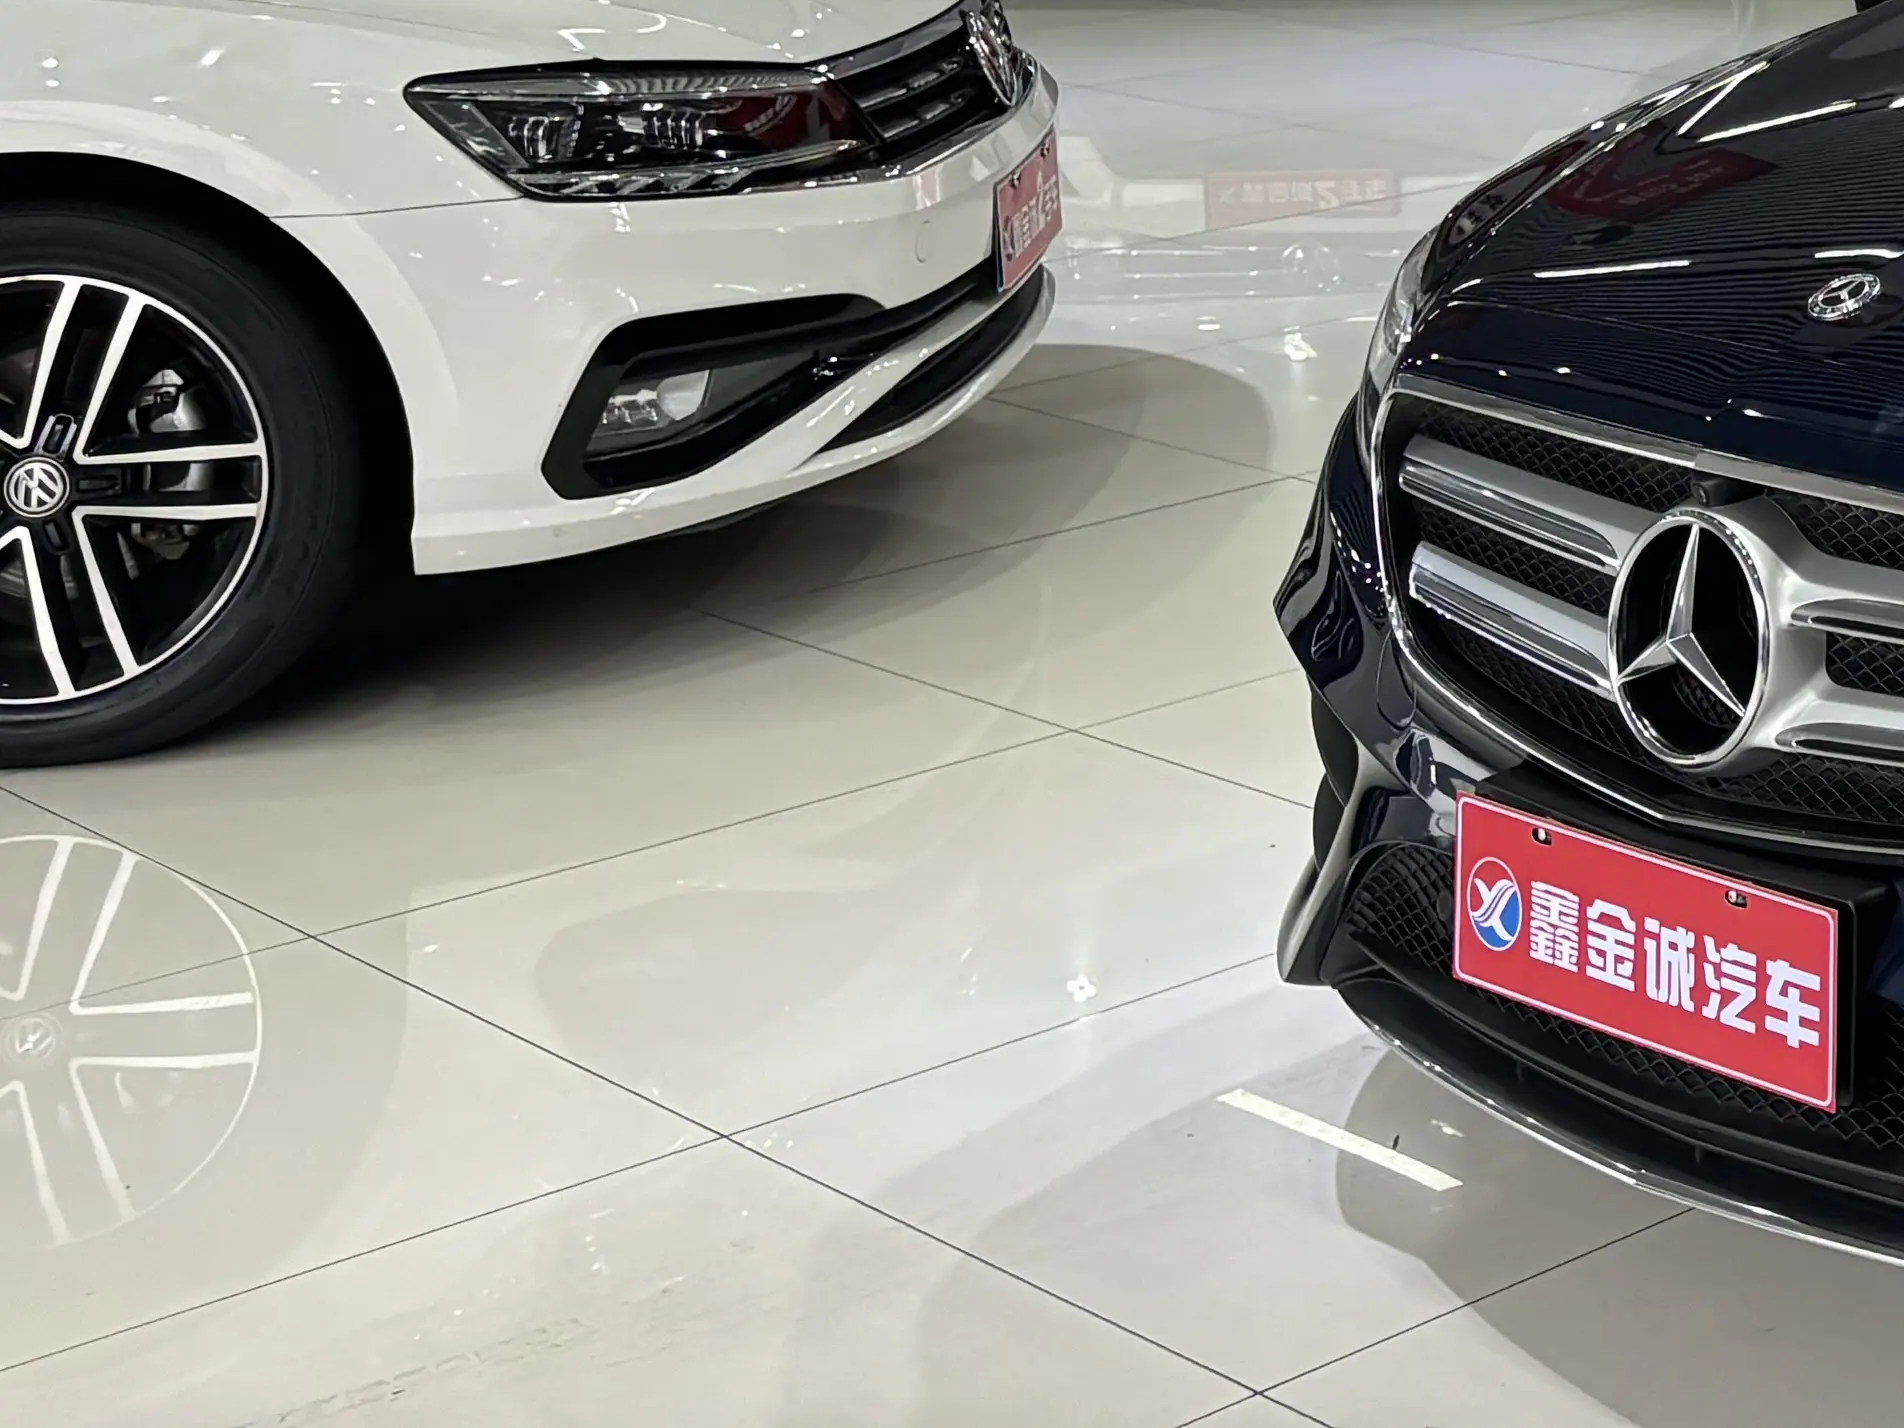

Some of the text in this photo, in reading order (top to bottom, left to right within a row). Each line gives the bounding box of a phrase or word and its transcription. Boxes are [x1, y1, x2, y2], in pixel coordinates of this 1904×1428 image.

[1529, 880, 1821, 1049] 鑫金诚汽车
